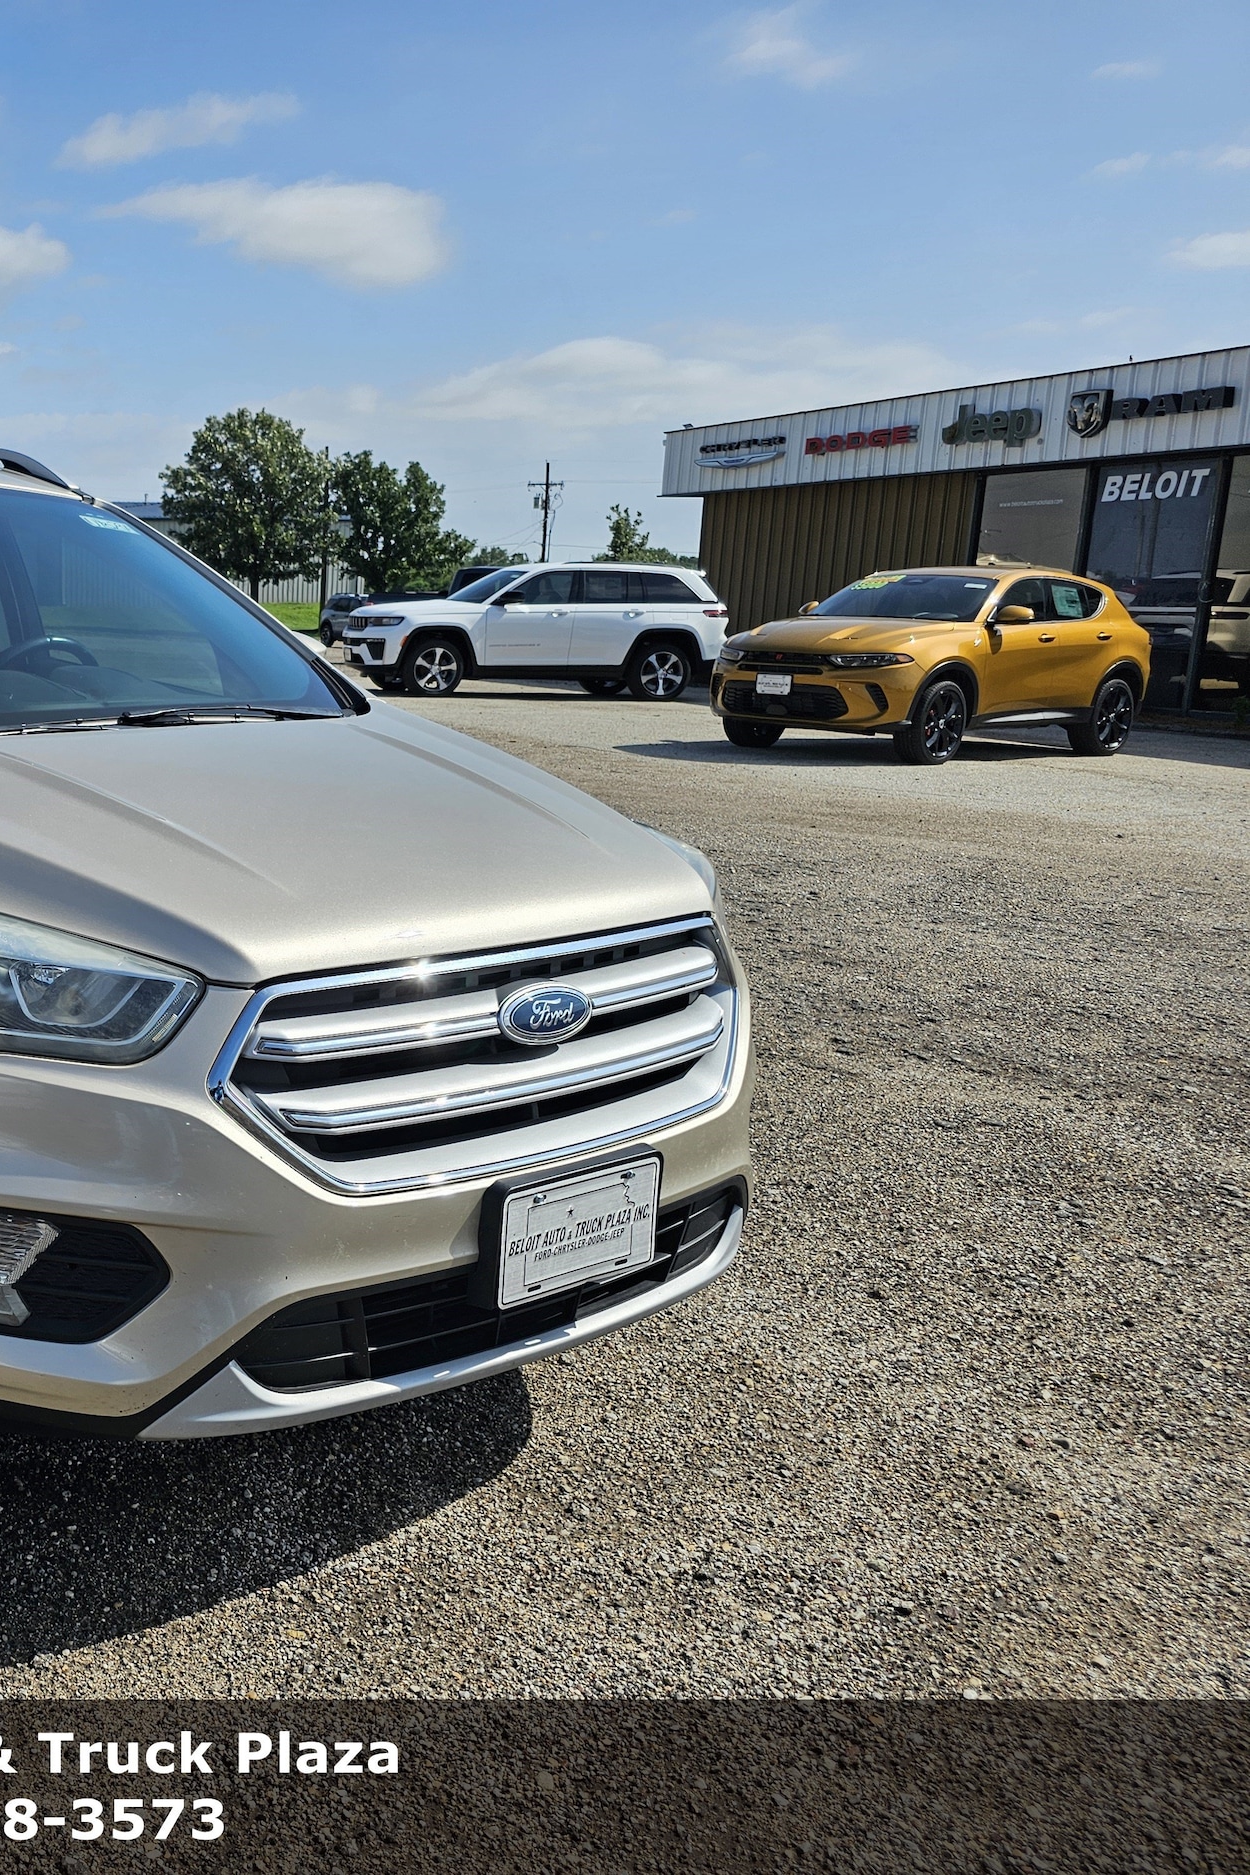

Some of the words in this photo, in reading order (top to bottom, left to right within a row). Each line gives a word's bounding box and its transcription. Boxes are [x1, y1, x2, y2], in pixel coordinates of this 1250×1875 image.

[1109, 386, 1235, 420] RAM
[805, 425, 915, 455] DODGE
[942, 404, 1041, 447] Jeep
[1101, 468, 1210, 503] BELOIT
[530, 998, 575, 1030] Ford
[509, 1233, 541, 1257] BELOIT
[542, 1226, 566, 1248] AUTO
[575, 1215, 604, 1238] TRUCK
[604, 1208, 631, 1230] PLAZA
[633, 1204, 650, 1221] INC.
